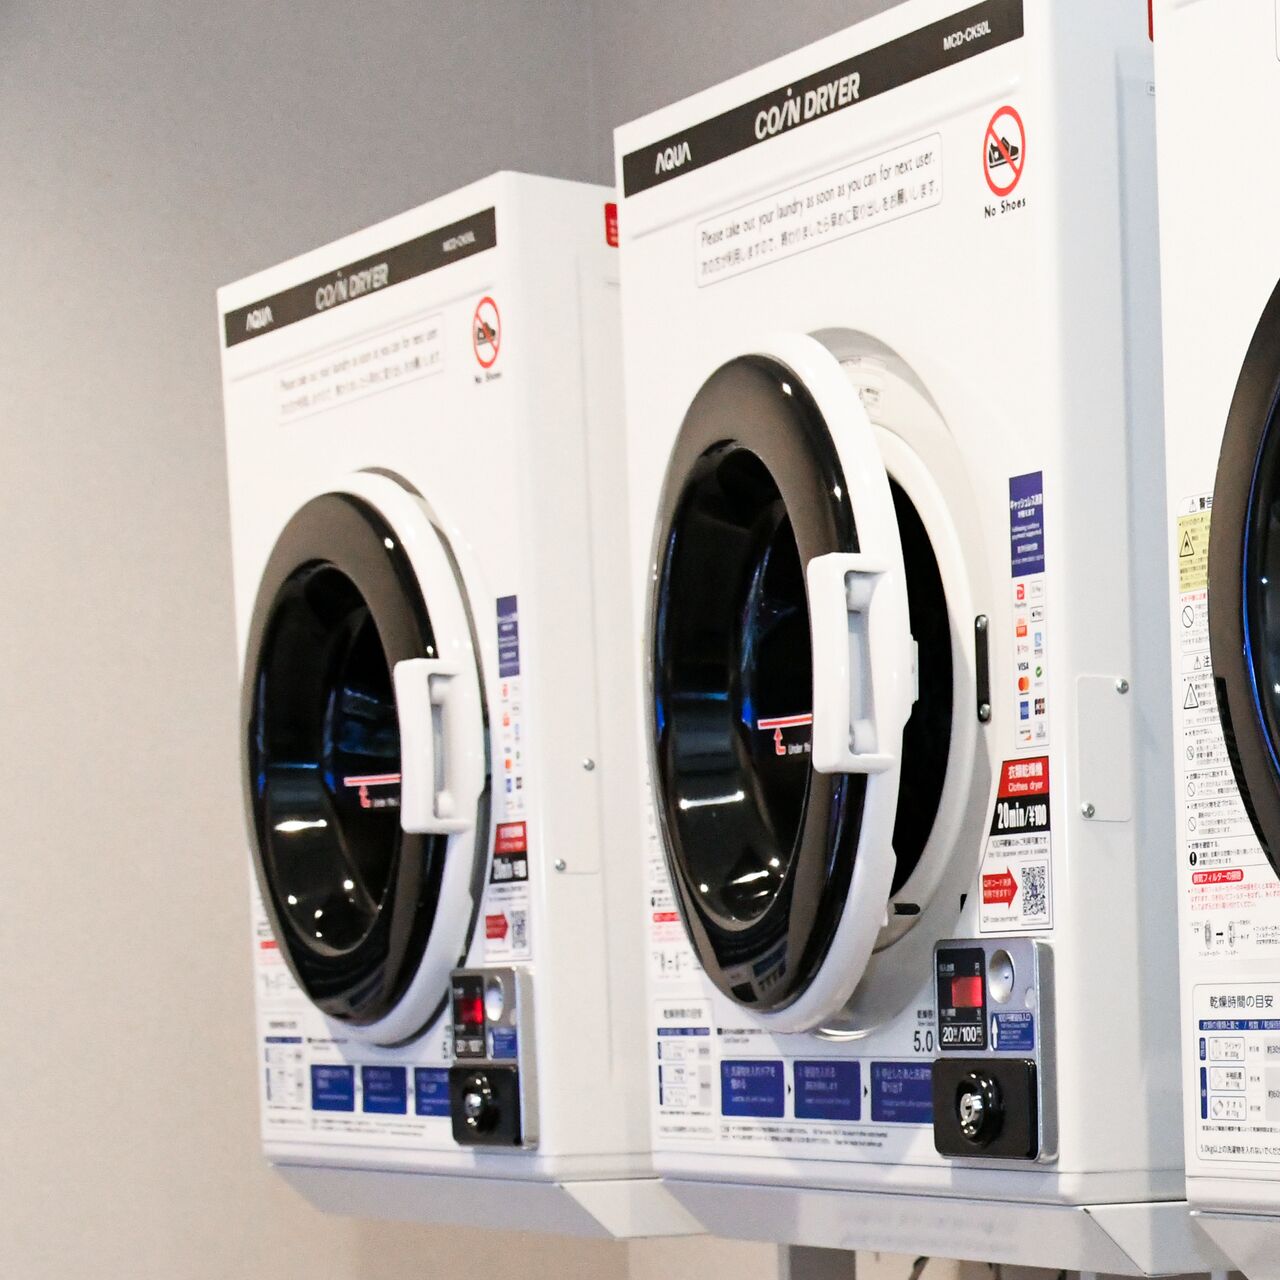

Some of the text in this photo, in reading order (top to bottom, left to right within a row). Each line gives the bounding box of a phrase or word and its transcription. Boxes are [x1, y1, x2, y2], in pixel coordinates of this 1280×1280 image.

[655, 142, 691, 175] AQUA
[803, 72, 861, 119] DRYER
[943, 21, 992, 50] MCD-CK50L
[984, 196, 1026, 219] No Shoes
[349, 262, 389, 298] DRYER
[1210, 995, 1274, 1009] 乾燥時間の目安
